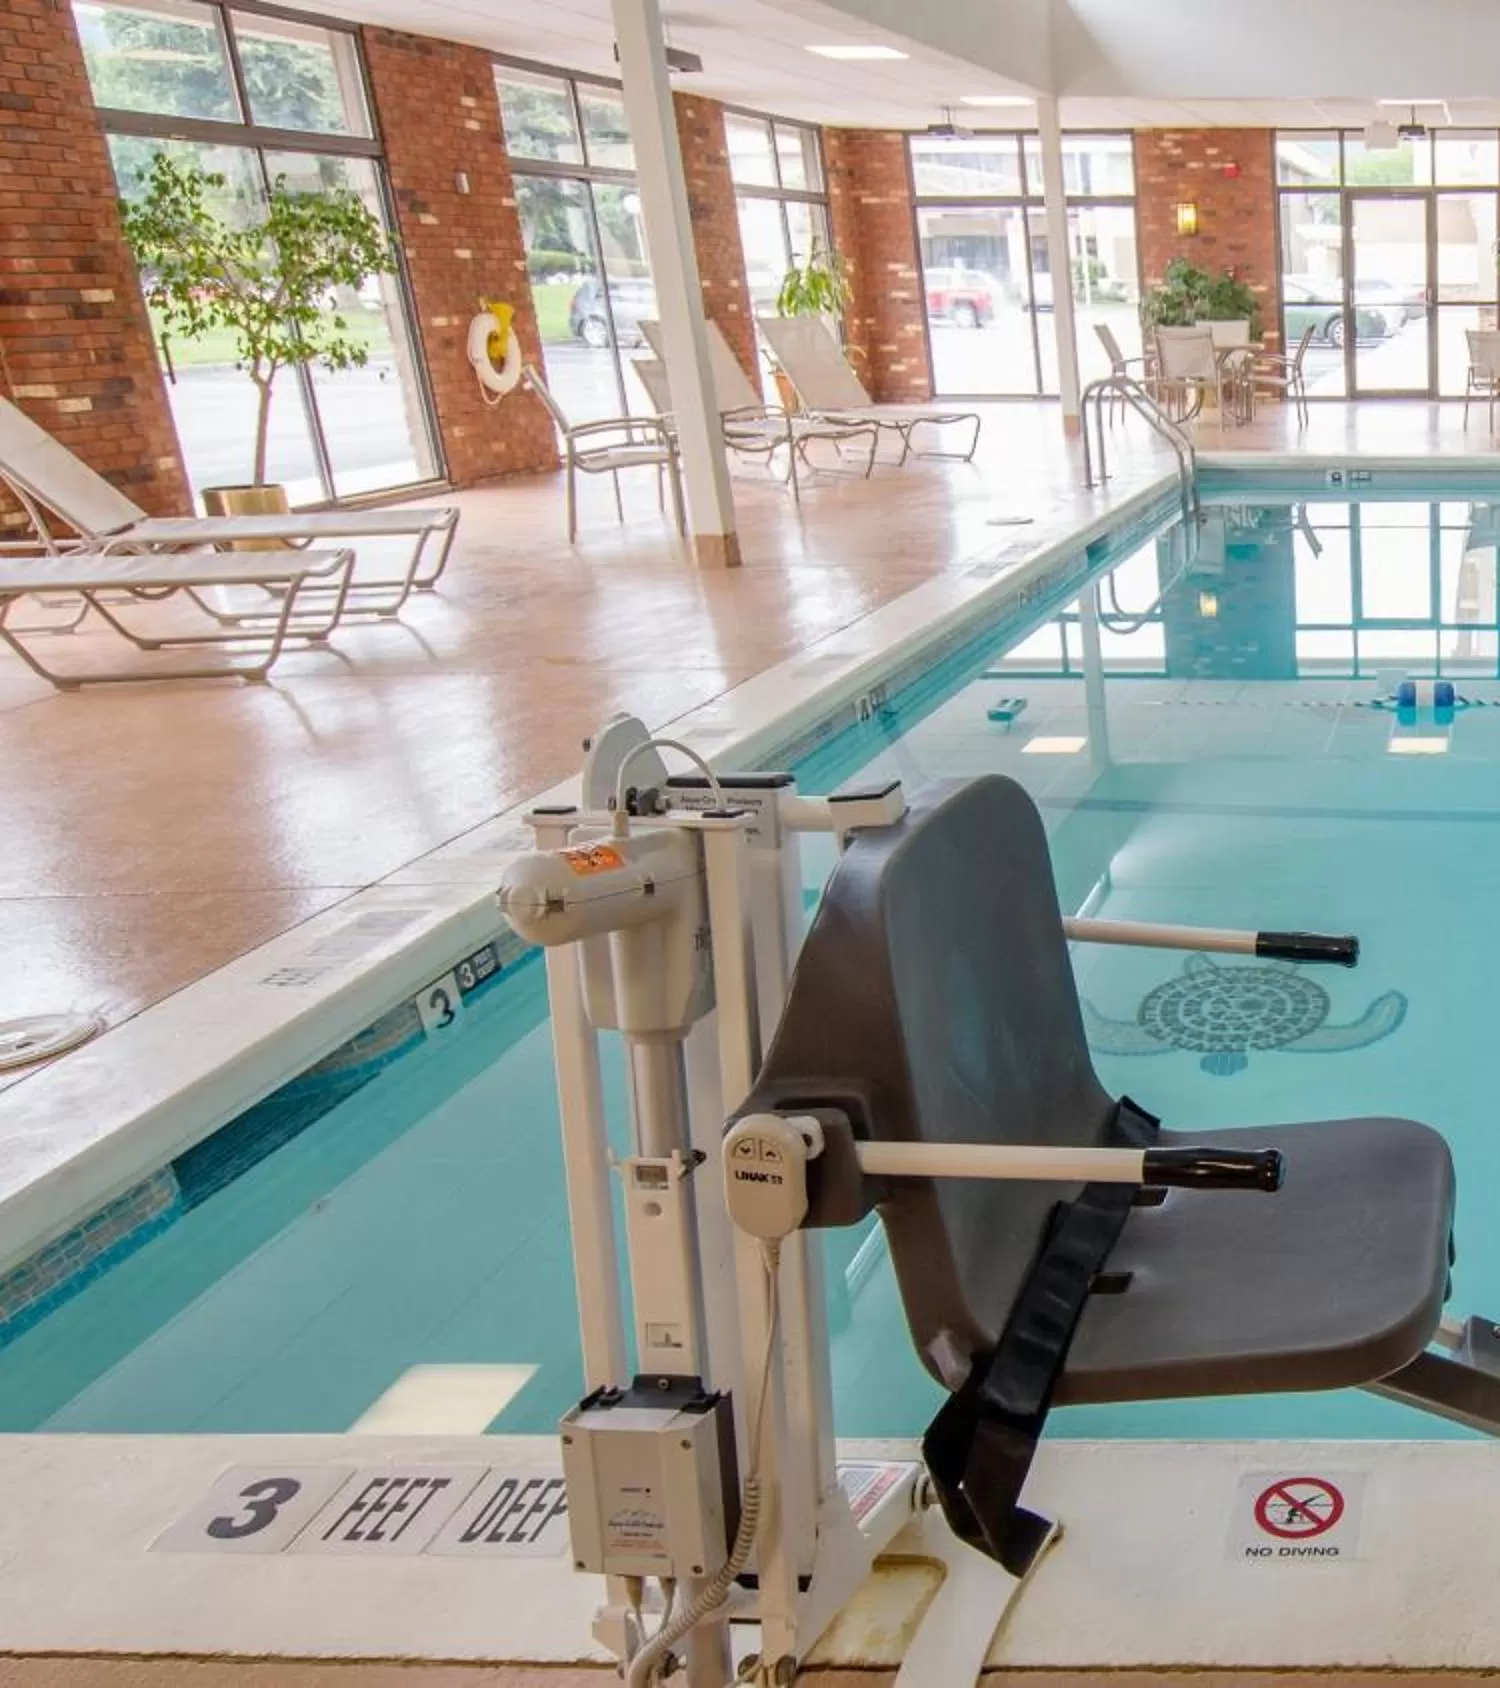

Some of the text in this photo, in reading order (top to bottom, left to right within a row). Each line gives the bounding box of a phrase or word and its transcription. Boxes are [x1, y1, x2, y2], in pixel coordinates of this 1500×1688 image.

[459, 962, 476, 989] 3
[429, 987, 456, 1029] 3
[735, 1170, 769, 1183] LINAK
[207, 1477, 301, 1540] 3
[320, 1477, 452, 1541] FEET
[1245, 1546, 1340, 1557] NO DIVING
